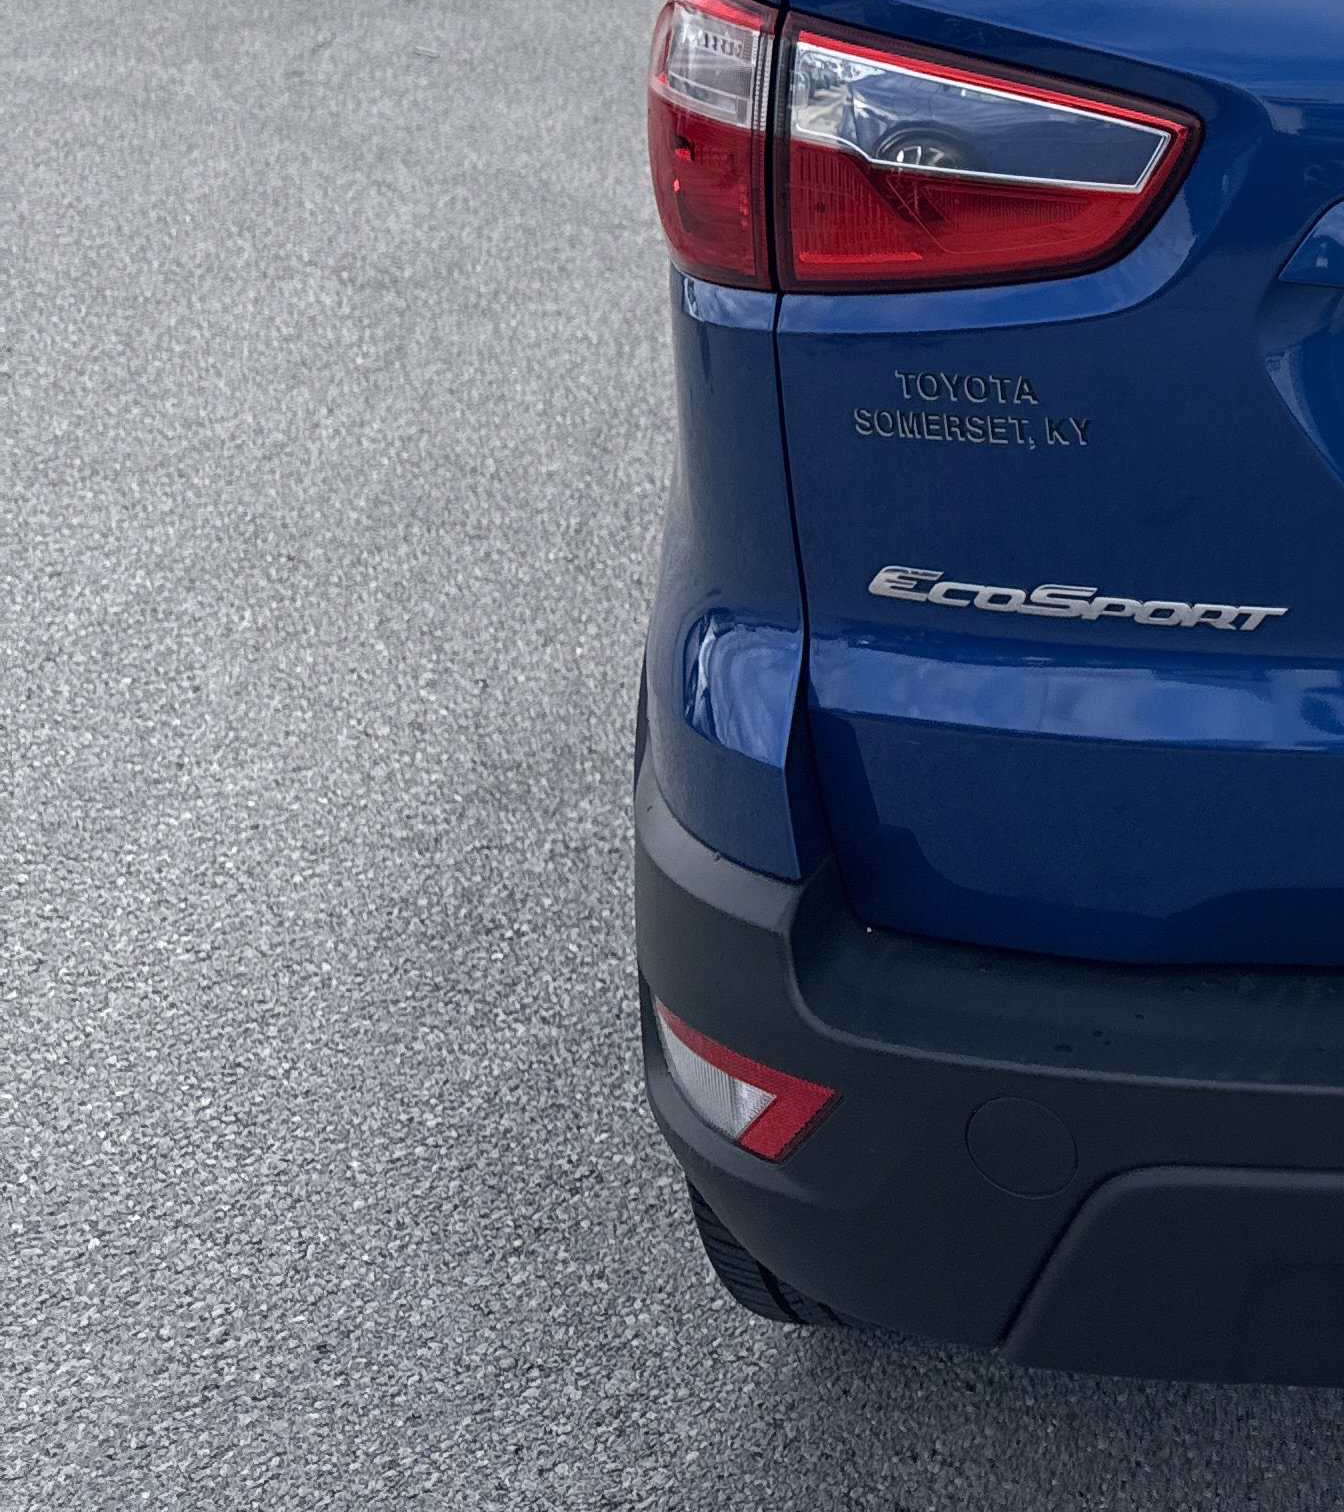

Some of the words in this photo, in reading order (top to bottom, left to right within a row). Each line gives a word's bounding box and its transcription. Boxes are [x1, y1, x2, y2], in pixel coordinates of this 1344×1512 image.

[895, 370, 1039, 405] TOYOTA
[853, 407, 1036, 450] SOMERSET,
[1046, 417, 1091, 446] KY
